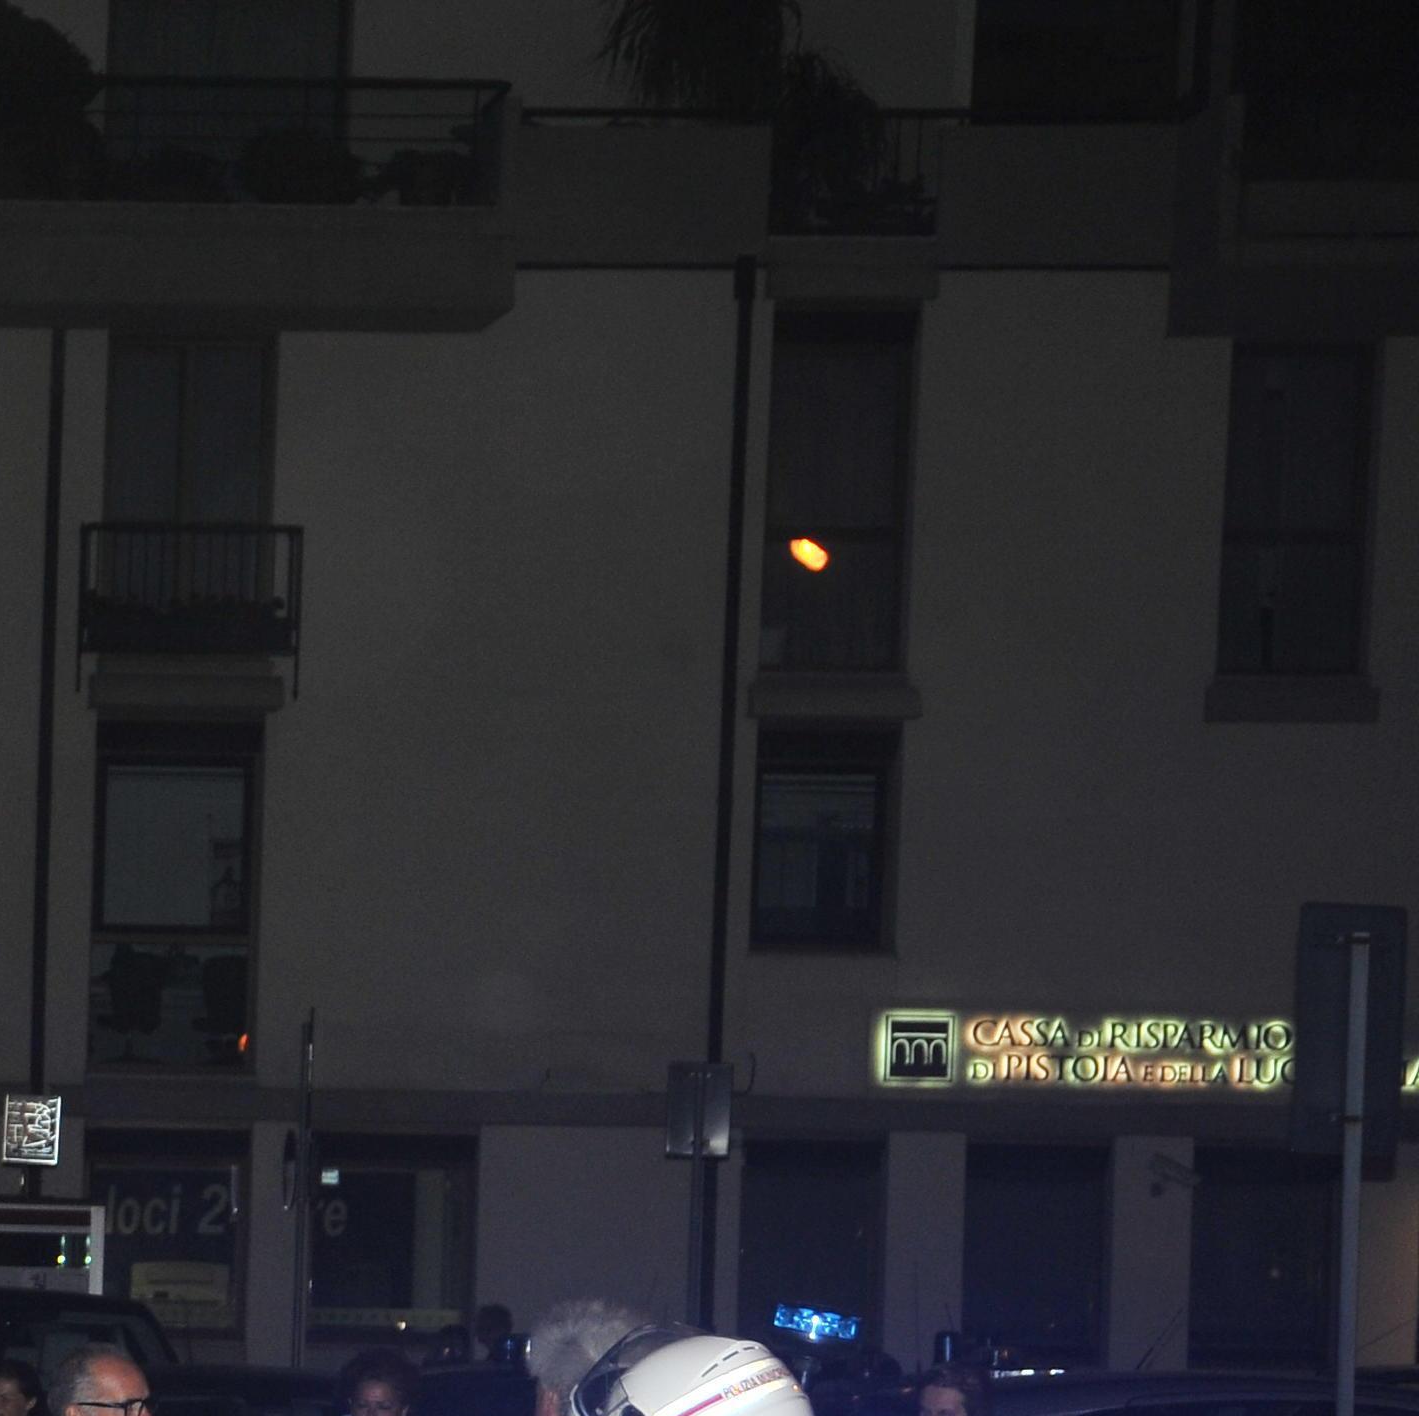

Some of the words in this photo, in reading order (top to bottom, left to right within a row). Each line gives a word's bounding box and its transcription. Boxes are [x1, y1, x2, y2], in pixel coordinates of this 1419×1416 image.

[971, 1018, 1069, 1048] CASSA
[1110, 1020, 1294, 1051] RISPARMIO
[971, 1061, 997, 1080] DI
[1003, 1054, 1134, 1083] PISTOIA
[1143, 1063, 1155, 1083] E
[1159, 1063, 1229, 1085] DELLA
